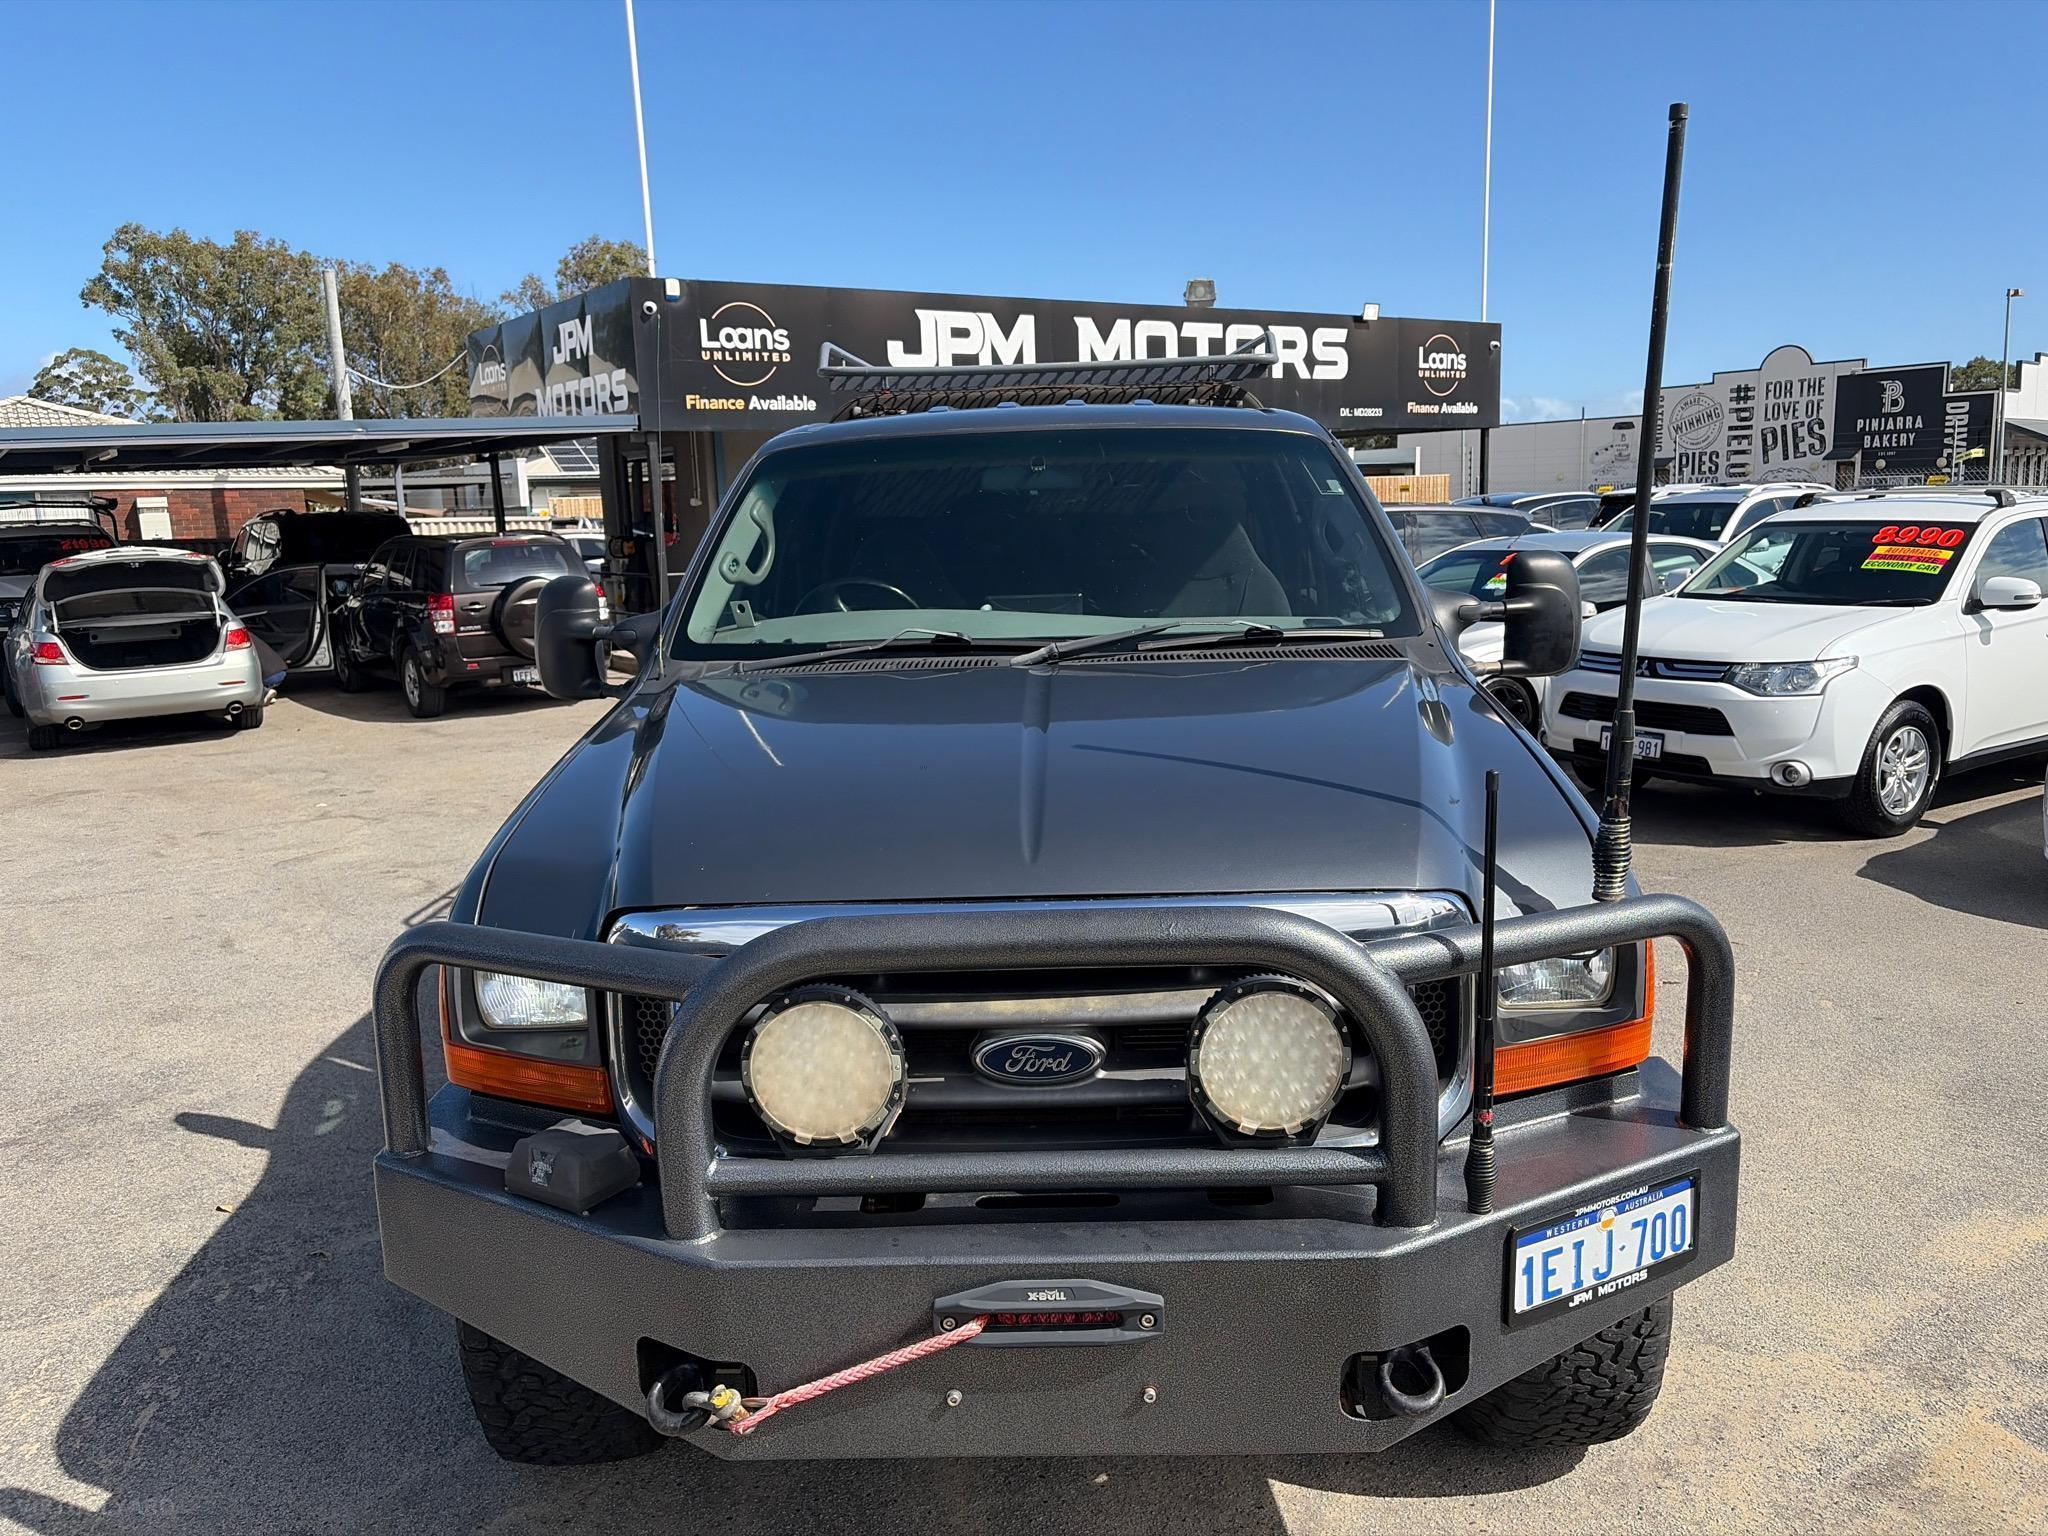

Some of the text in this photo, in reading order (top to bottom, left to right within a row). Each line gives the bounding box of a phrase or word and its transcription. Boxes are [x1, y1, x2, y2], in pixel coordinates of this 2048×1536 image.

[552, 315, 595, 366] JPM
[700, 318, 791, 351] Loans
[887, 308, 1350, 381] JPM MOTORS
[701, 351, 792, 363] UNLIMITED
[1418, 346, 1467, 370] Loans
[478, 362, 507, 386] Loans
[1418, 370, 1467, 379] UNLIMITED
[535, 368, 629, 417] MOTORS
[1765, 376, 1826, 401] FOR THE
[686, 394, 817, 412] Finance Available
[1407, 402, 1479, 415] Finance Available
[1764, 399, 1824, 422] LOVE OF
[1672, 406, 1721, 435] WINNING
[1856, 415, 1924, 433] PINJARRA
[1761, 417, 1827, 464] PIES
[1863, 432, 1916, 449] BAKERY
[1678, 450, 1720, 476] PIES
[1872, 526, 1965, 547] 8990
[1884, 547, 1943, 557] AUTOMATIC
[1863, 560, 1940, 573] ECONOMY CAR
[1005, 1045, 1073, 1072] Ford
[1574, 1185, 1649, 1218] JPMMOTORS.COM.AU
[1546, 1191, 1664, 1238] WESTERN AUSTRALIA
[1027, 1290, 1067, 1301] X-BULL
[1568, 1268, 1648, 1308] JPM MOTORS
